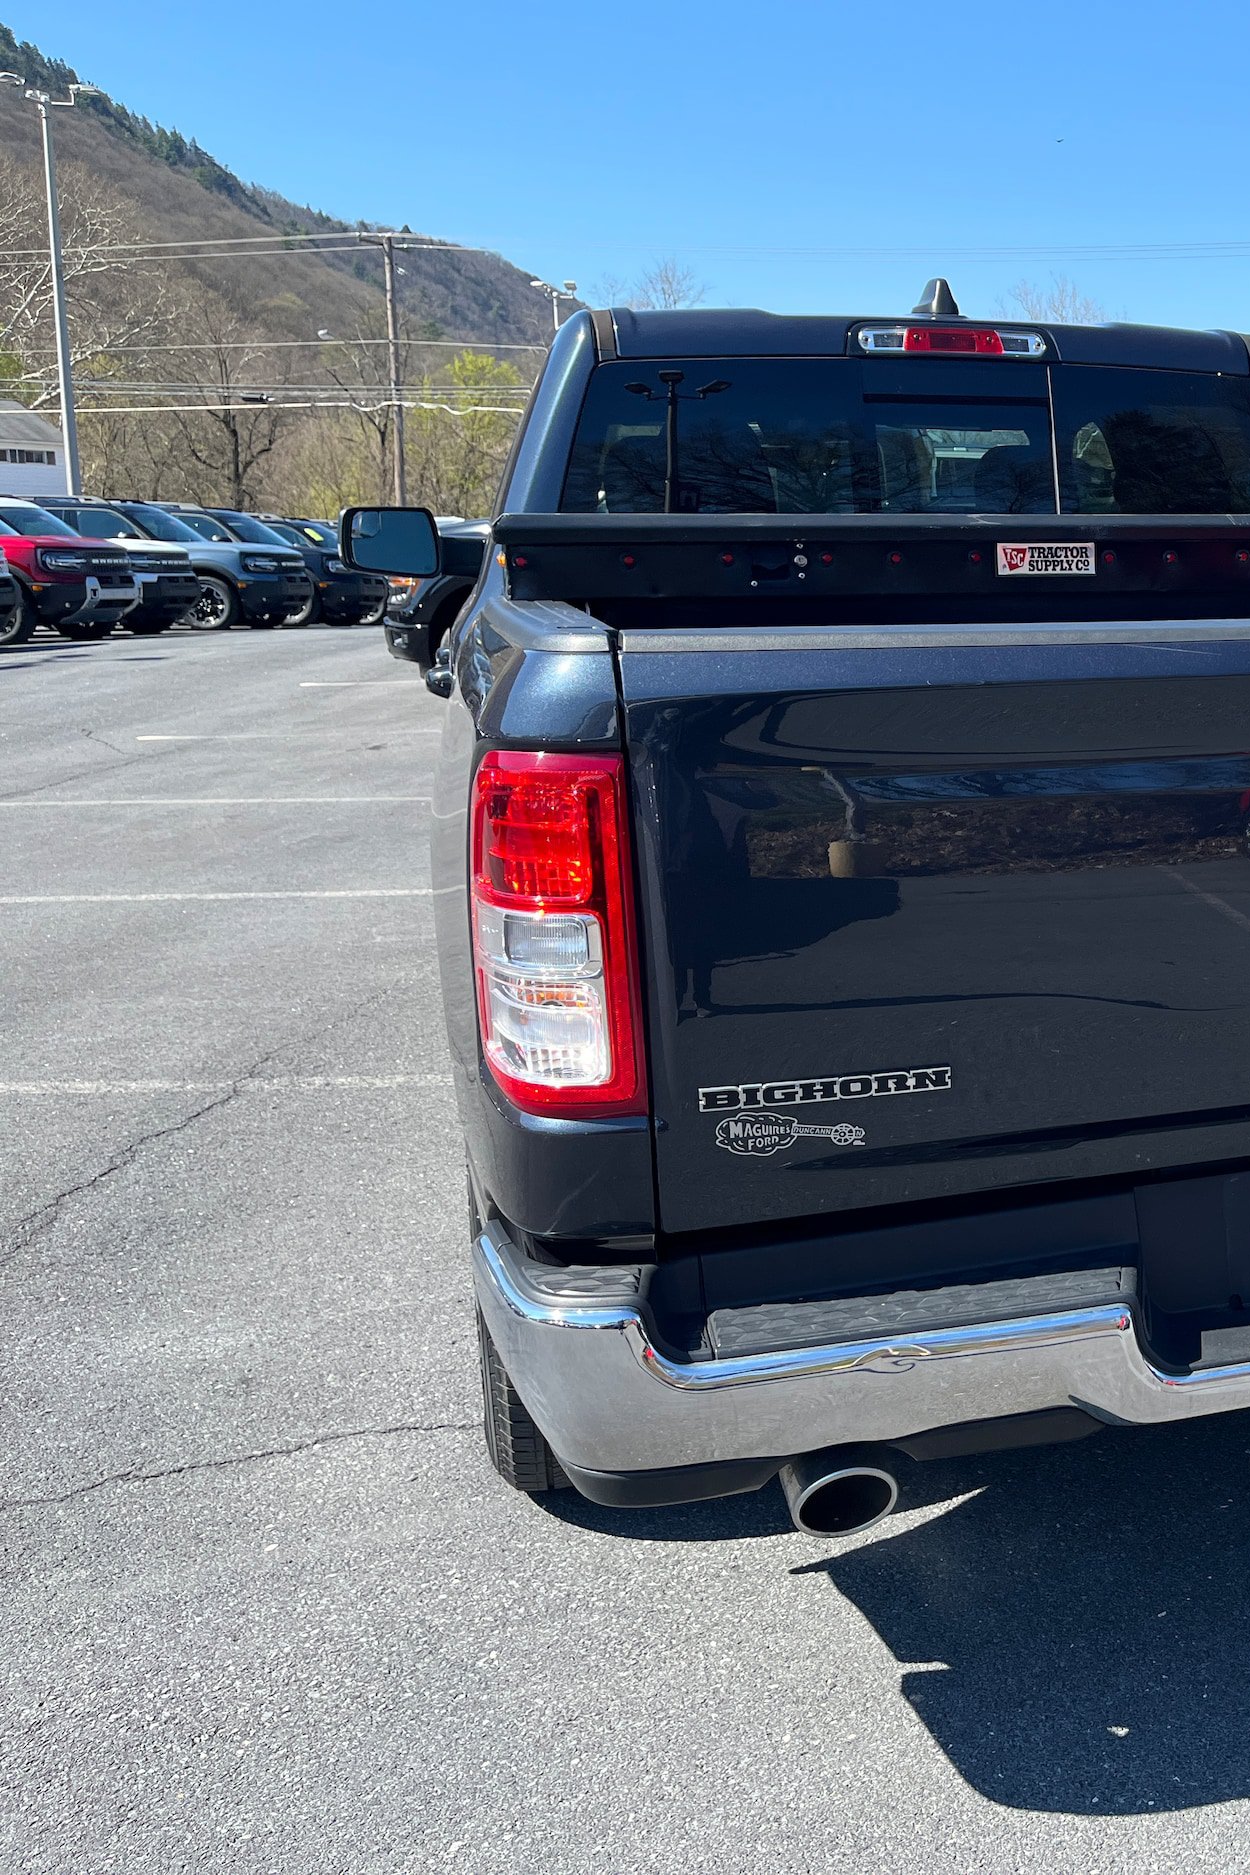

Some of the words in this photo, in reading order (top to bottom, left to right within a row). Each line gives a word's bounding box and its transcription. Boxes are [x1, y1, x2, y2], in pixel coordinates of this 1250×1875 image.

[1005, 549, 1024, 567] TSC
[1028, 547, 1088, 559] TRACTOR
[1028, 560, 1075, 572] SUPPLY
[698, 1066, 952, 1113] BIGHORN
[747, 1135, 779, 1151] FORD
